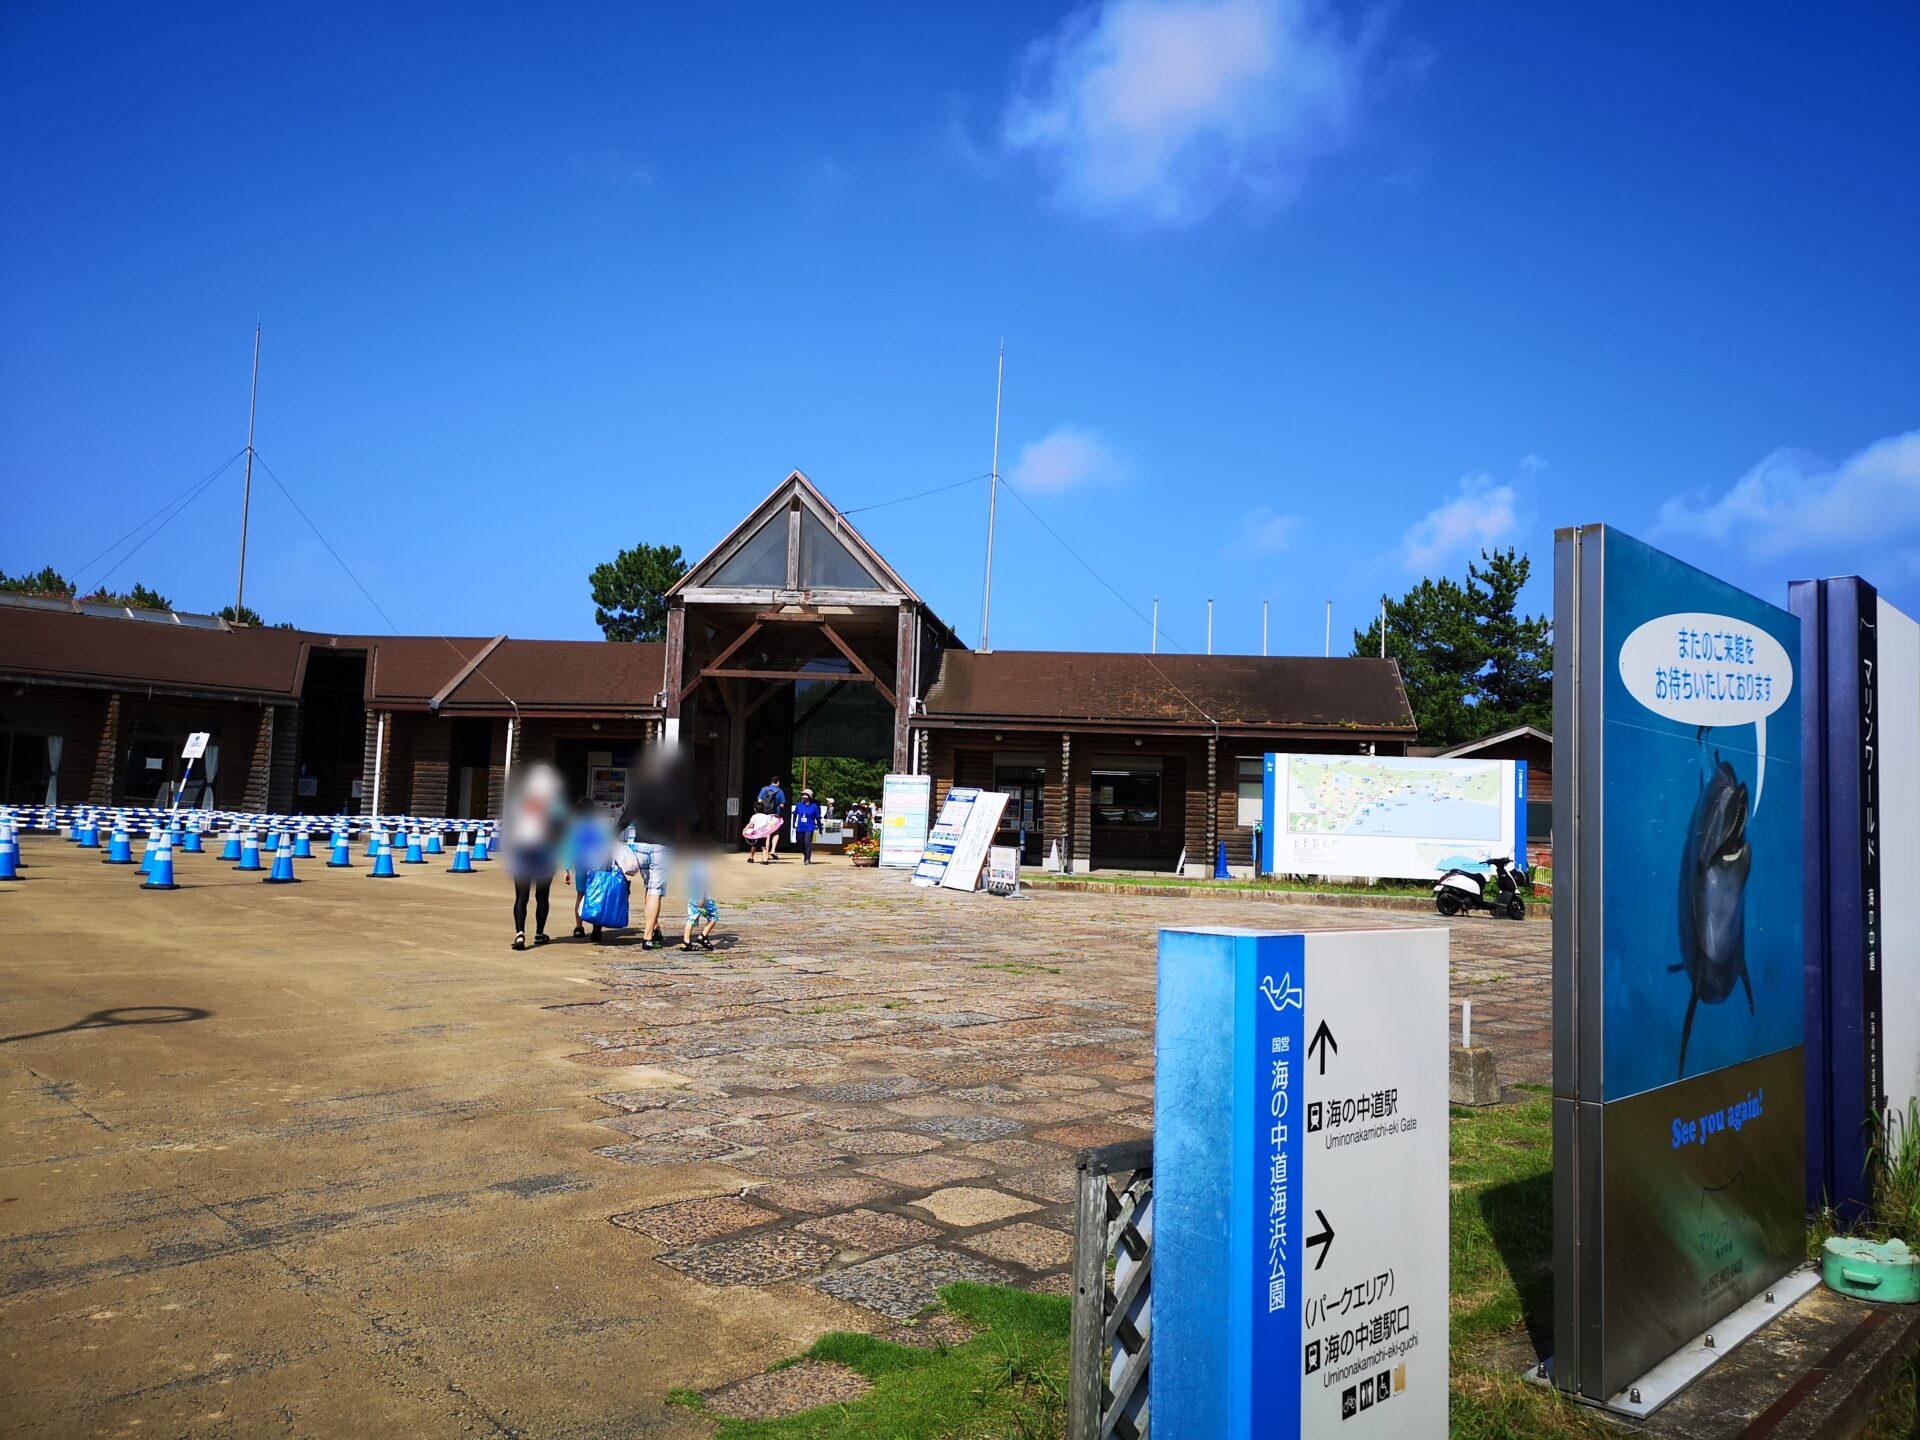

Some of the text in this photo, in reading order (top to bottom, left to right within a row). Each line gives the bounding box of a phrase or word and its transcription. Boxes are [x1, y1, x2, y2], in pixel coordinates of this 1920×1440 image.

[1678, 627, 1755, 664] またのご来館を
[1655, 666, 1772, 702] お待ちいたしております
[1863, 658, 1875, 865] マリンワールド
[1272, 1035, 1291, 1053] 国営
[1325, 1117, 1418, 1150] Uminonakamichi-eki Gate
[1326, 1088, 1398, 1129] 海の中道駅
[1672, 1087, 1764, 1149] See you again!
[1269, 1059, 1290, 1314] 海の中道海浜公園
[1305, 1268, 1395, 1330] （パークエリア）
[1323, 1331, 1419, 1388] Uminonakamichi-eki-guchi
[1324, 1305, 1410, 1367] 海の中道駅口
